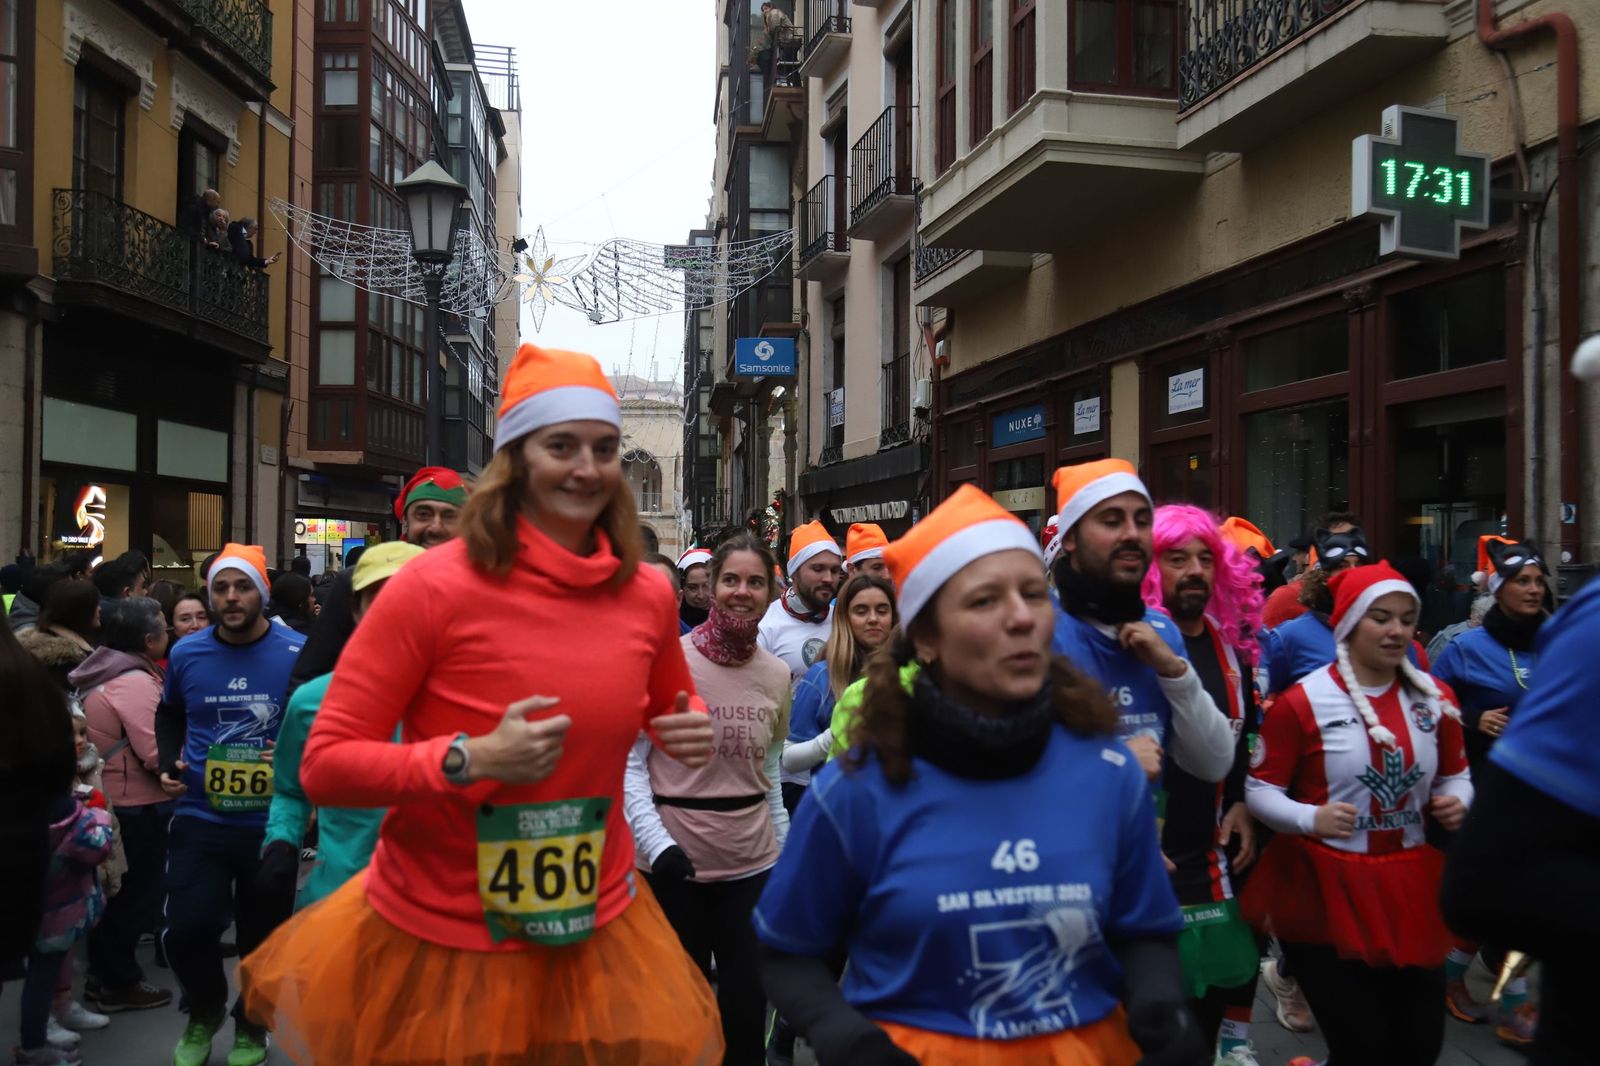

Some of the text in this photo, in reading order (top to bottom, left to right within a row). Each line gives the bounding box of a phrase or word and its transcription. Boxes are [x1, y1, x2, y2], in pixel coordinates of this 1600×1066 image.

[1381, 159, 1470, 206] 17:31
[739, 363, 791, 373] Samsonite
[1008, 416, 1033, 433] NUXE
[881, 500, 908, 520] WORLD
[228, 677, 247, 690] 46
[219, 695, 252, 703] SILVESTRE
[708, 705, 767, 722] MUSEO
[723, 726, 756, 740] DEL
[209, 767, 268, 795] 856
[991, 838, 1040, 874] 46
[489, 841, 596, 903] 466
[937, 891, 971, 913] SAN
[972, 884, 1055, 908] SILVESTRE
[526, 920, 566, 936] CAJA
